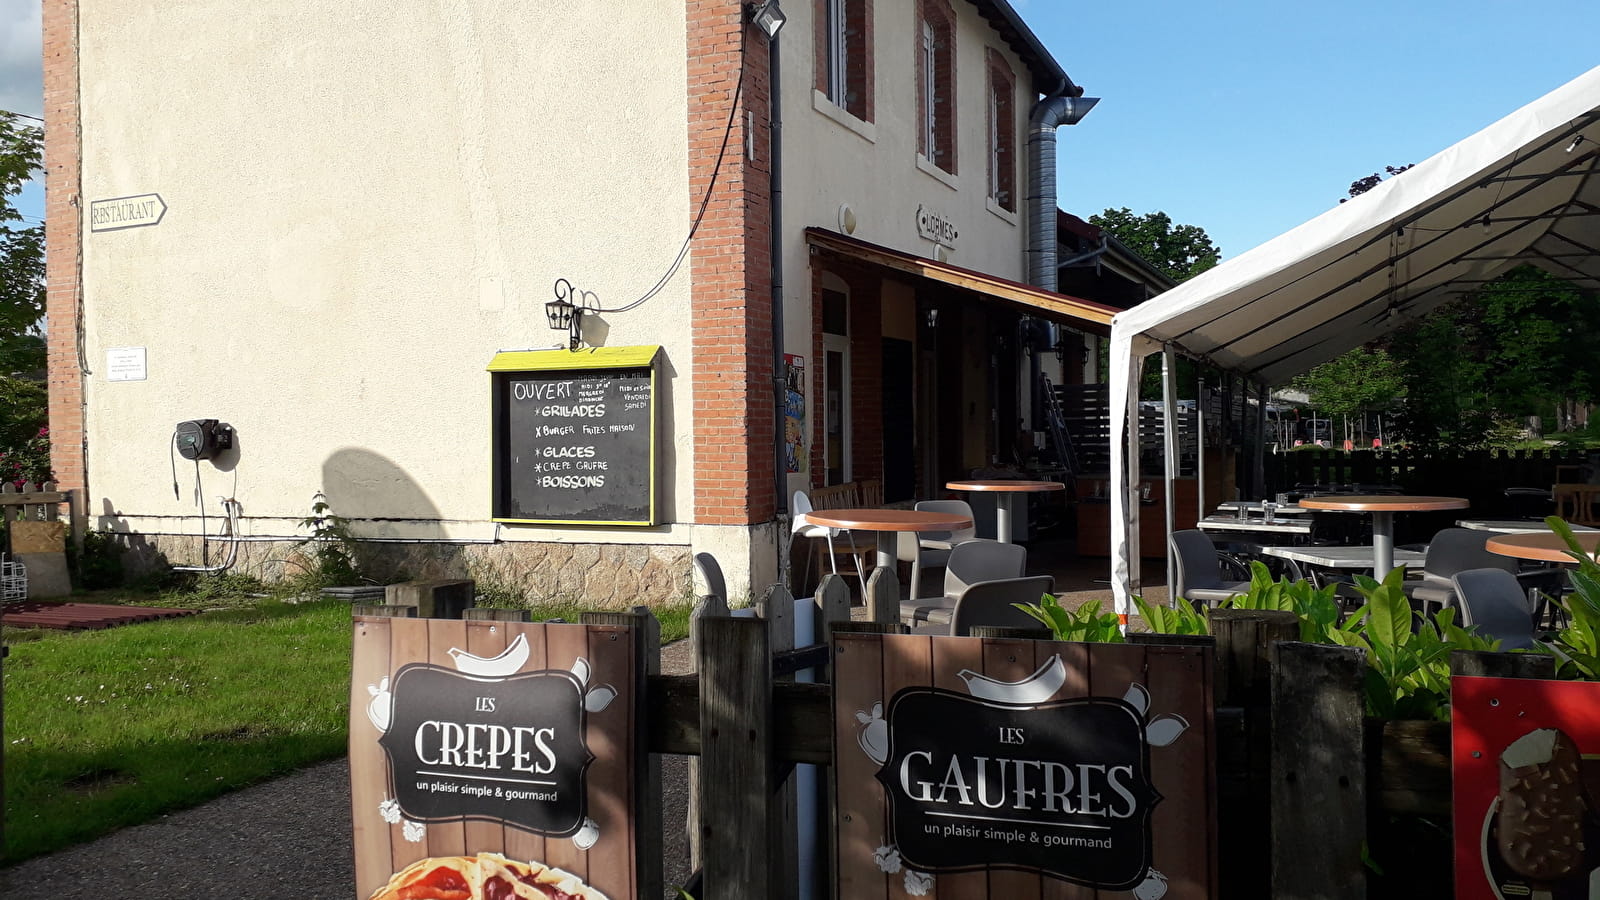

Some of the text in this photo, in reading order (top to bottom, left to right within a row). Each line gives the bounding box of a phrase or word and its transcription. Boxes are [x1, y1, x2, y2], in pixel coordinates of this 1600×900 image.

[93, 201, 156, 224] RESTAURANT
[926, 213, 954, 242] LORMES
[514, 381, 573, 400] OUVERT
[541, 404, 606, 418] GRILLADES
[543, 446, 596, 458] GLACES
[543, 461, 609, 471] CREPE GAUFRE
[542, 475, 605, 489] BOISSONS
[475, 697, 496, 712] LES
[999, 727, 1025, 744] LES
[414, 720, 557, 775] CREPES
[416, 781, 558, 802] un plaisir simple & gourmand
[900, 751, 1137, 819] GAUFRES
[924, 824, 1112, 849] un plaisir simple & gourmand
